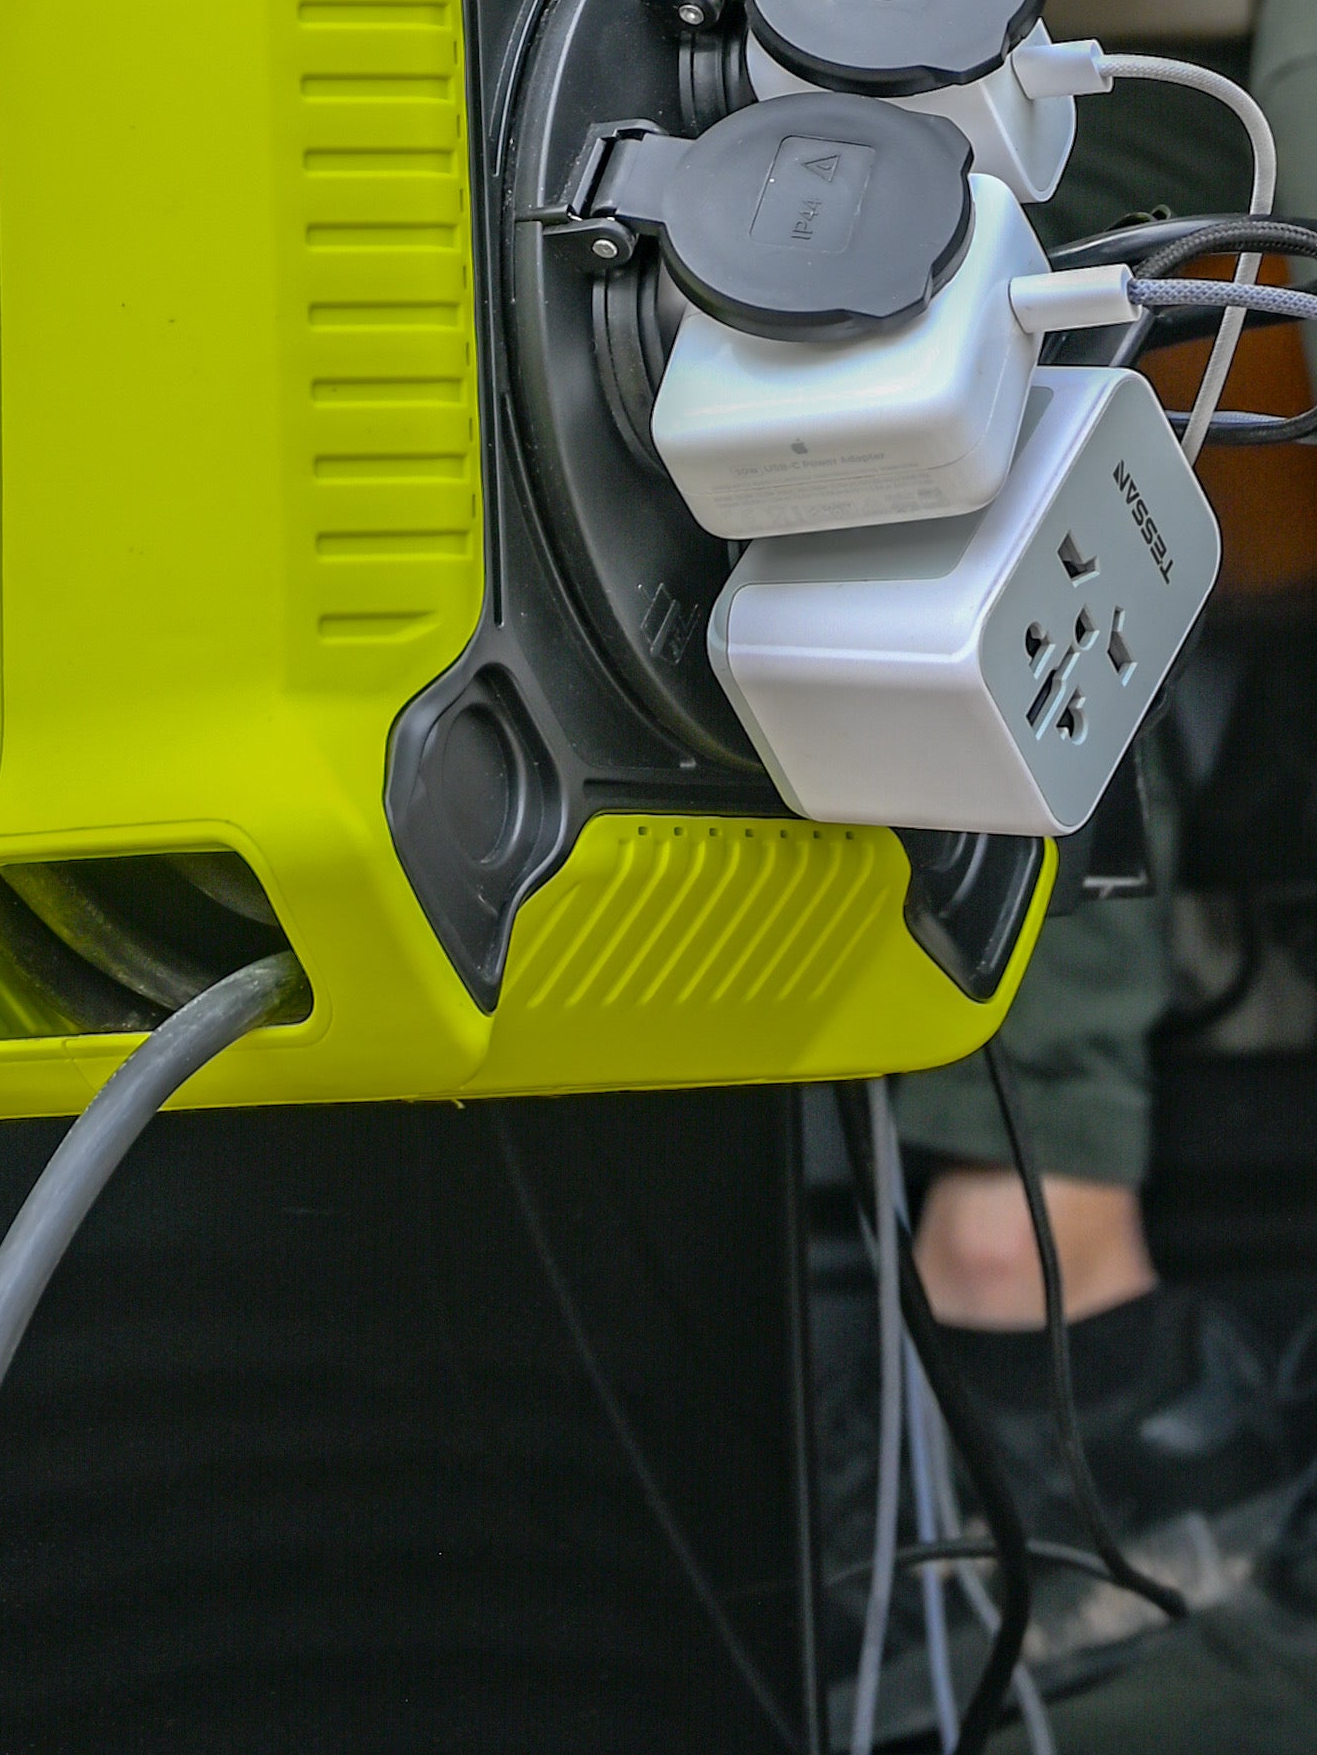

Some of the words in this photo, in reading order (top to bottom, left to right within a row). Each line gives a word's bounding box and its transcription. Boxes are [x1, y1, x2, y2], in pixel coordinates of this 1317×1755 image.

[790, 199, 822, 241] IP44
[802, 457, 837, 469] Power
[840, 452, 885, 464] Adapter
[1112, 458, 1174, 585] TESSAN
